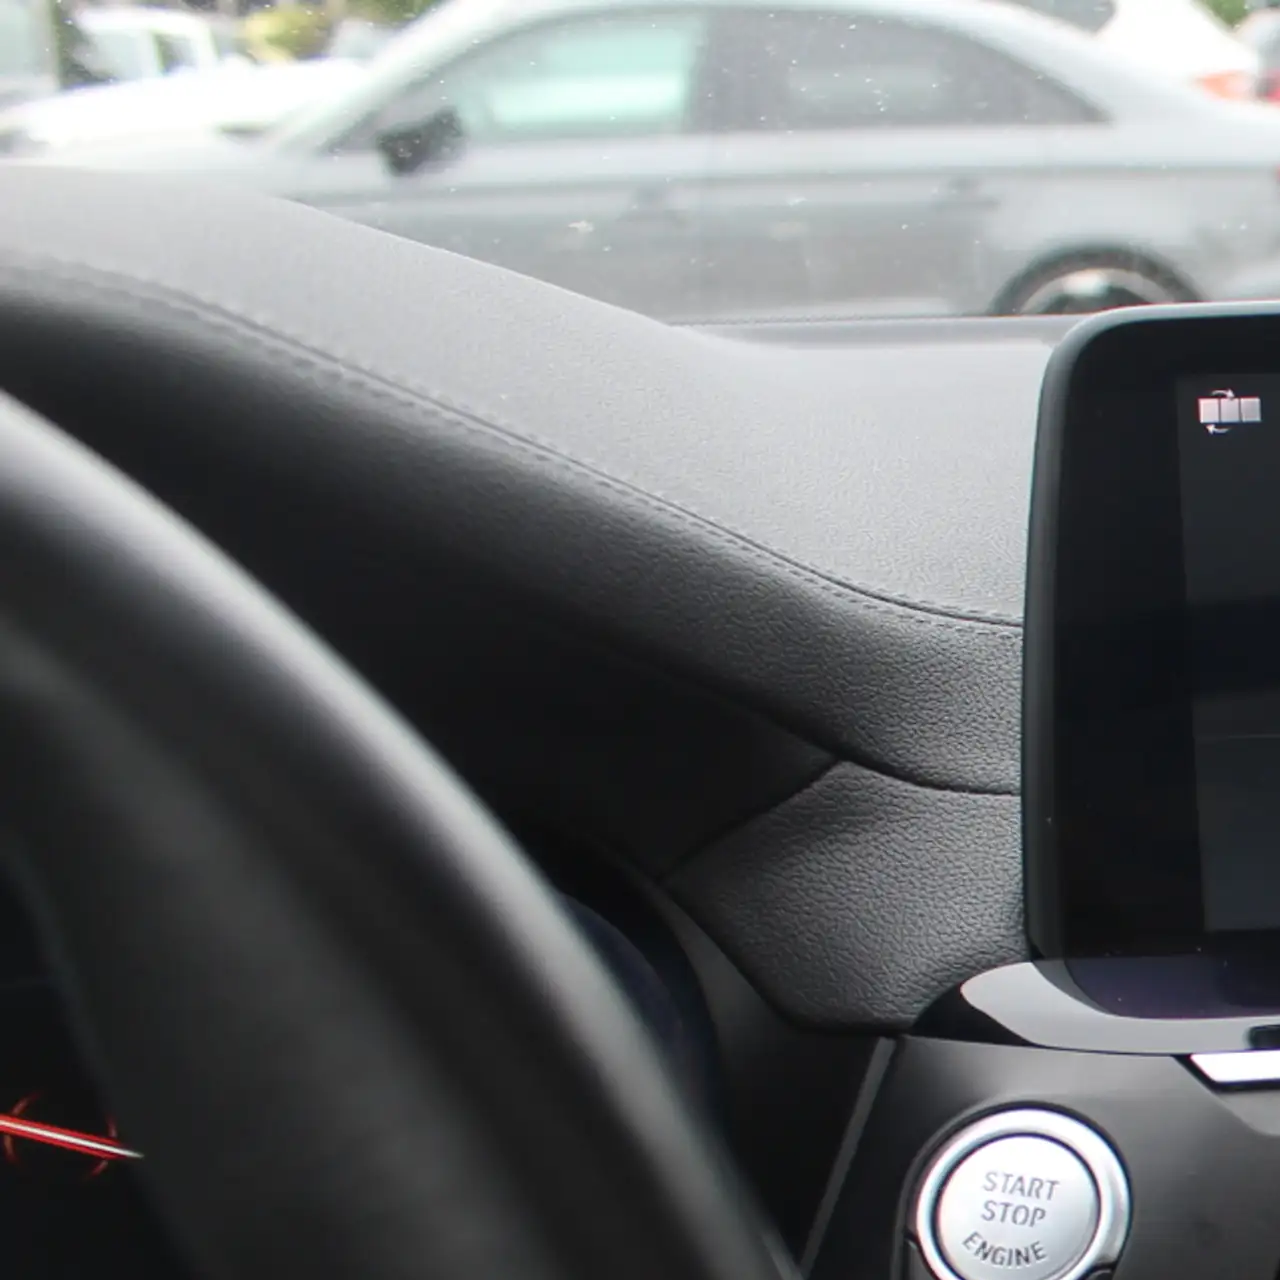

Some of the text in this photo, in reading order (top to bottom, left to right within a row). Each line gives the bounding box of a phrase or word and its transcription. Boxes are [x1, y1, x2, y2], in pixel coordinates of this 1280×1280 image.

[982, 1171, 1061, 1201] START
[981, 1200, 1046, 1227] STOP
[961, 1231, 1048, 1267] ENGINE
